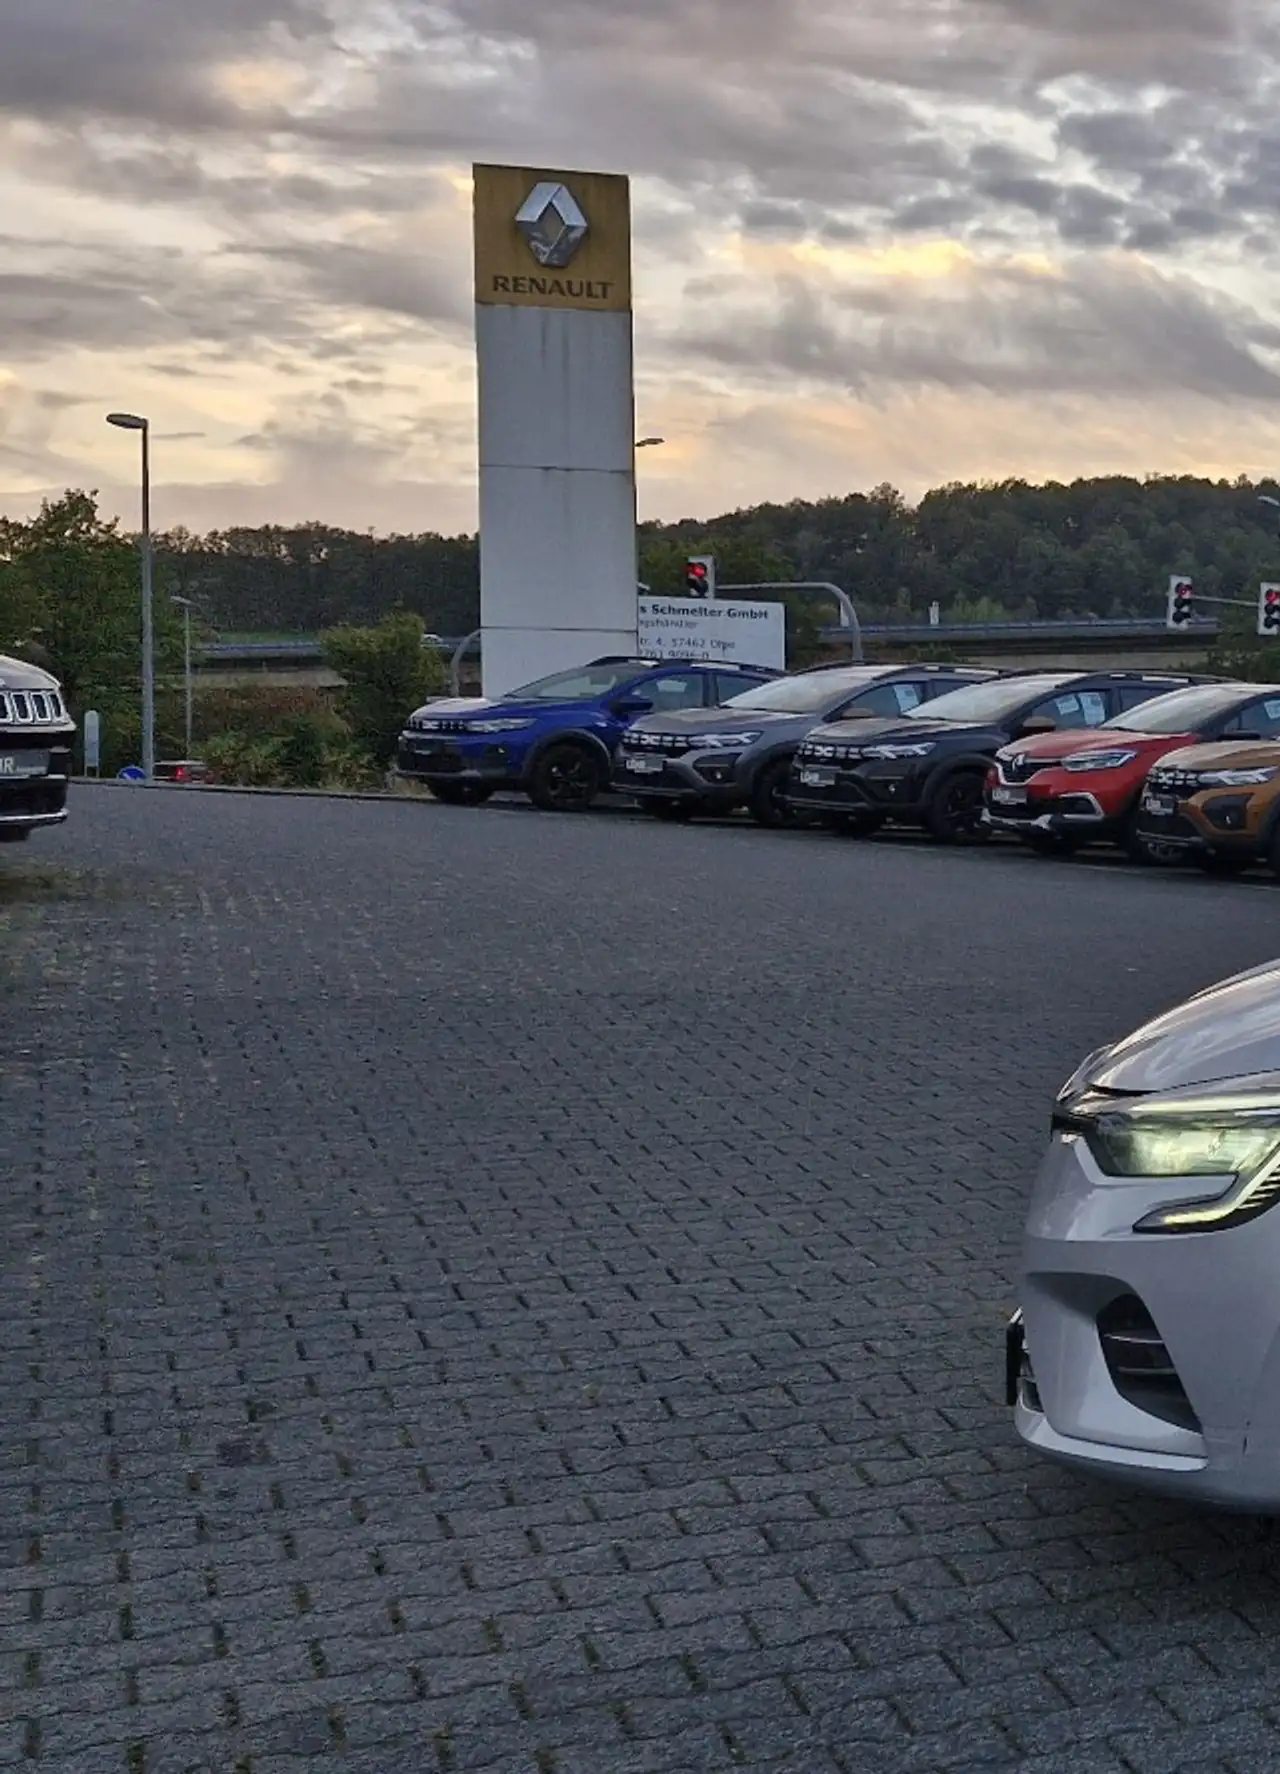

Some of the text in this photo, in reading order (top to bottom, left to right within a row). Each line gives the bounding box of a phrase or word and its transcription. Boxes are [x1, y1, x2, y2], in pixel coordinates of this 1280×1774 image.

[492, 275, 616, 299] RENAULT
[652, 604, 723, 617] Schmelter
[727, 608, 769, 620] GmbH
